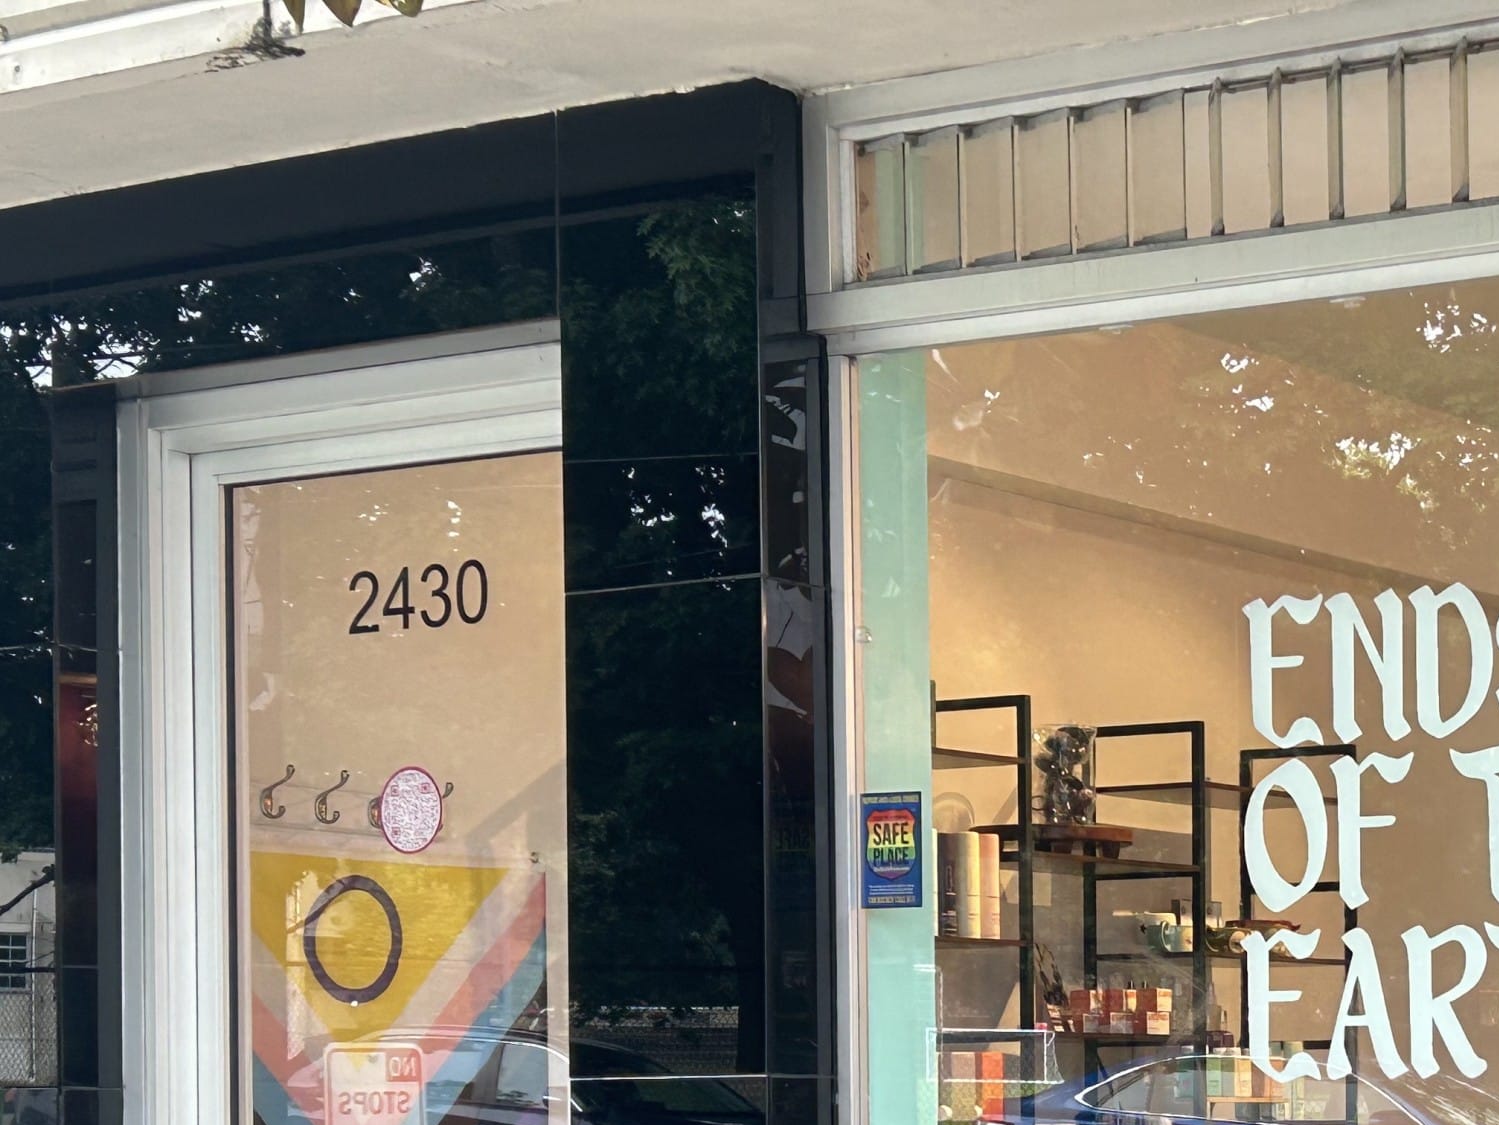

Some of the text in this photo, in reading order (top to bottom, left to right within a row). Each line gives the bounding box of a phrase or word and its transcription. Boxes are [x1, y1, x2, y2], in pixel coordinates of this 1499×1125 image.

[349, 559, 489, 636] 2430
[873, 822, 910, 846] SAFE
[873, 846, 909, 867] PLACE
[1244, 752, 1414, 913] OF
